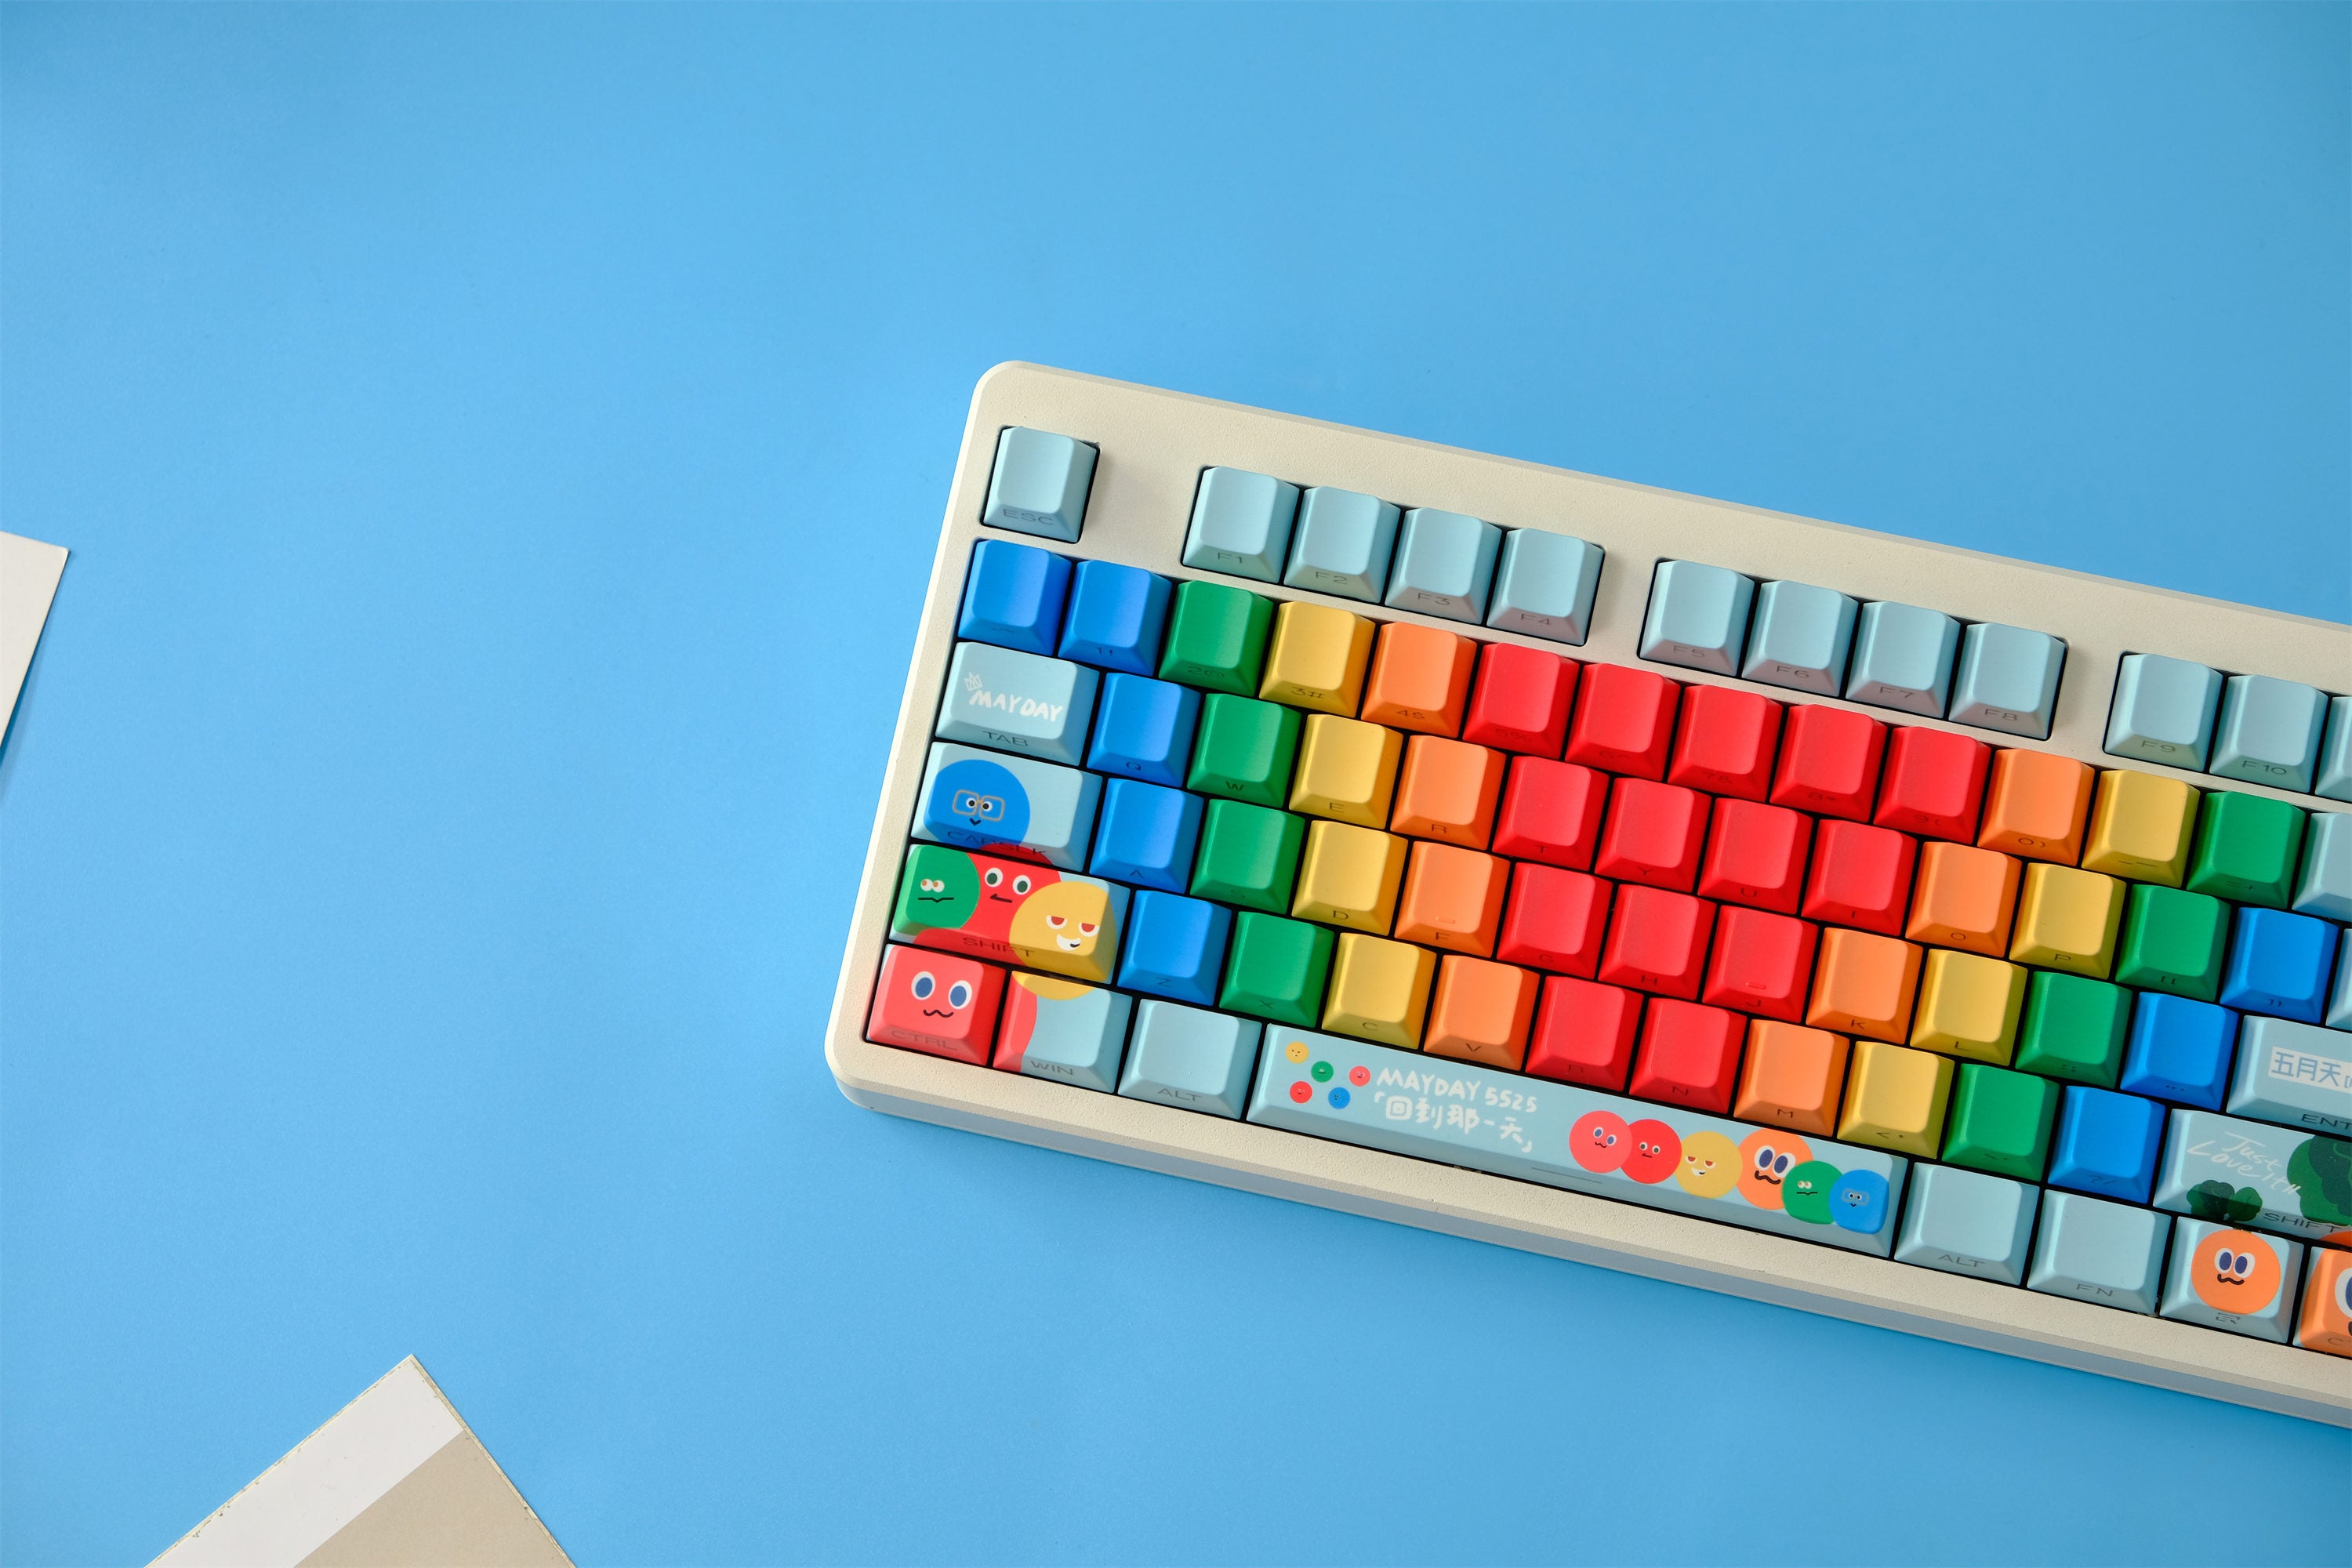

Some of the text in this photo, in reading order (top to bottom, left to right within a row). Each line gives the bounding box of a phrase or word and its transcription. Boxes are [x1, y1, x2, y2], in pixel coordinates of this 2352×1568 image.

[1003, 508, 1054, 526] ESC
[1218, 552, 1243, 564] F1
[1315, 571, 1348, 585] F2
[1417, 592, 1450, 606] F3
[1520, 612, 1552, 626] F4
[1673, 644, 1705, 659] F5
[1776, 665, 1809, 679] F6
[1879, 686, 1916, 699] F7
[968, 688, 1063, 722] MAYDAY
[1984, 708, 2018, 721] F8
[982, 730, 1029, 746] TAB
[2141, 739, 2176, 753] F9
[1126, 761, 1142, 771] Q
[2241, 760, 2288, 776] F10
[1225, 780, 1244, 791] W
[1329, 802, 1345, 813] E
[1431, 823, 1446, 834] R
[1333, 909, 1349, 920] D
[1435, 931, 1451, 942] F
[962, 936, 1036, 957] SHIFT
[2054, 953, 2071, 962] P
[1156, 977, 1172, 987] Z
[1259, 999, 1274, 1010] X
[1362, 1022, 1378, 1031] C
[1851, 1019, 1866, 1030] K
[890, 1029, 959, 1051] CTRL
[1465, 1042, 1482, 1052] V
[1955, 1040, 1969, 1052] L
[1030, 1060, 1074, 1076] WIN
[1156, 1087, 1204, 1102] ALT
[1376, 1067, 1537, 1113] MAYDAY 5525
[1671, 1085, 1689, 1096] N
[1777, 1108, 1794, 1119] M
[2222, 1131, 2282, 1171] Just
[2187, 1140, 2262, 1178] Love
[2263, 1212, 2343, 1233] SHIFT
[1937, 1254, 1985, 1268] ALT
[2075, 1283, 2114, 1298] FN
